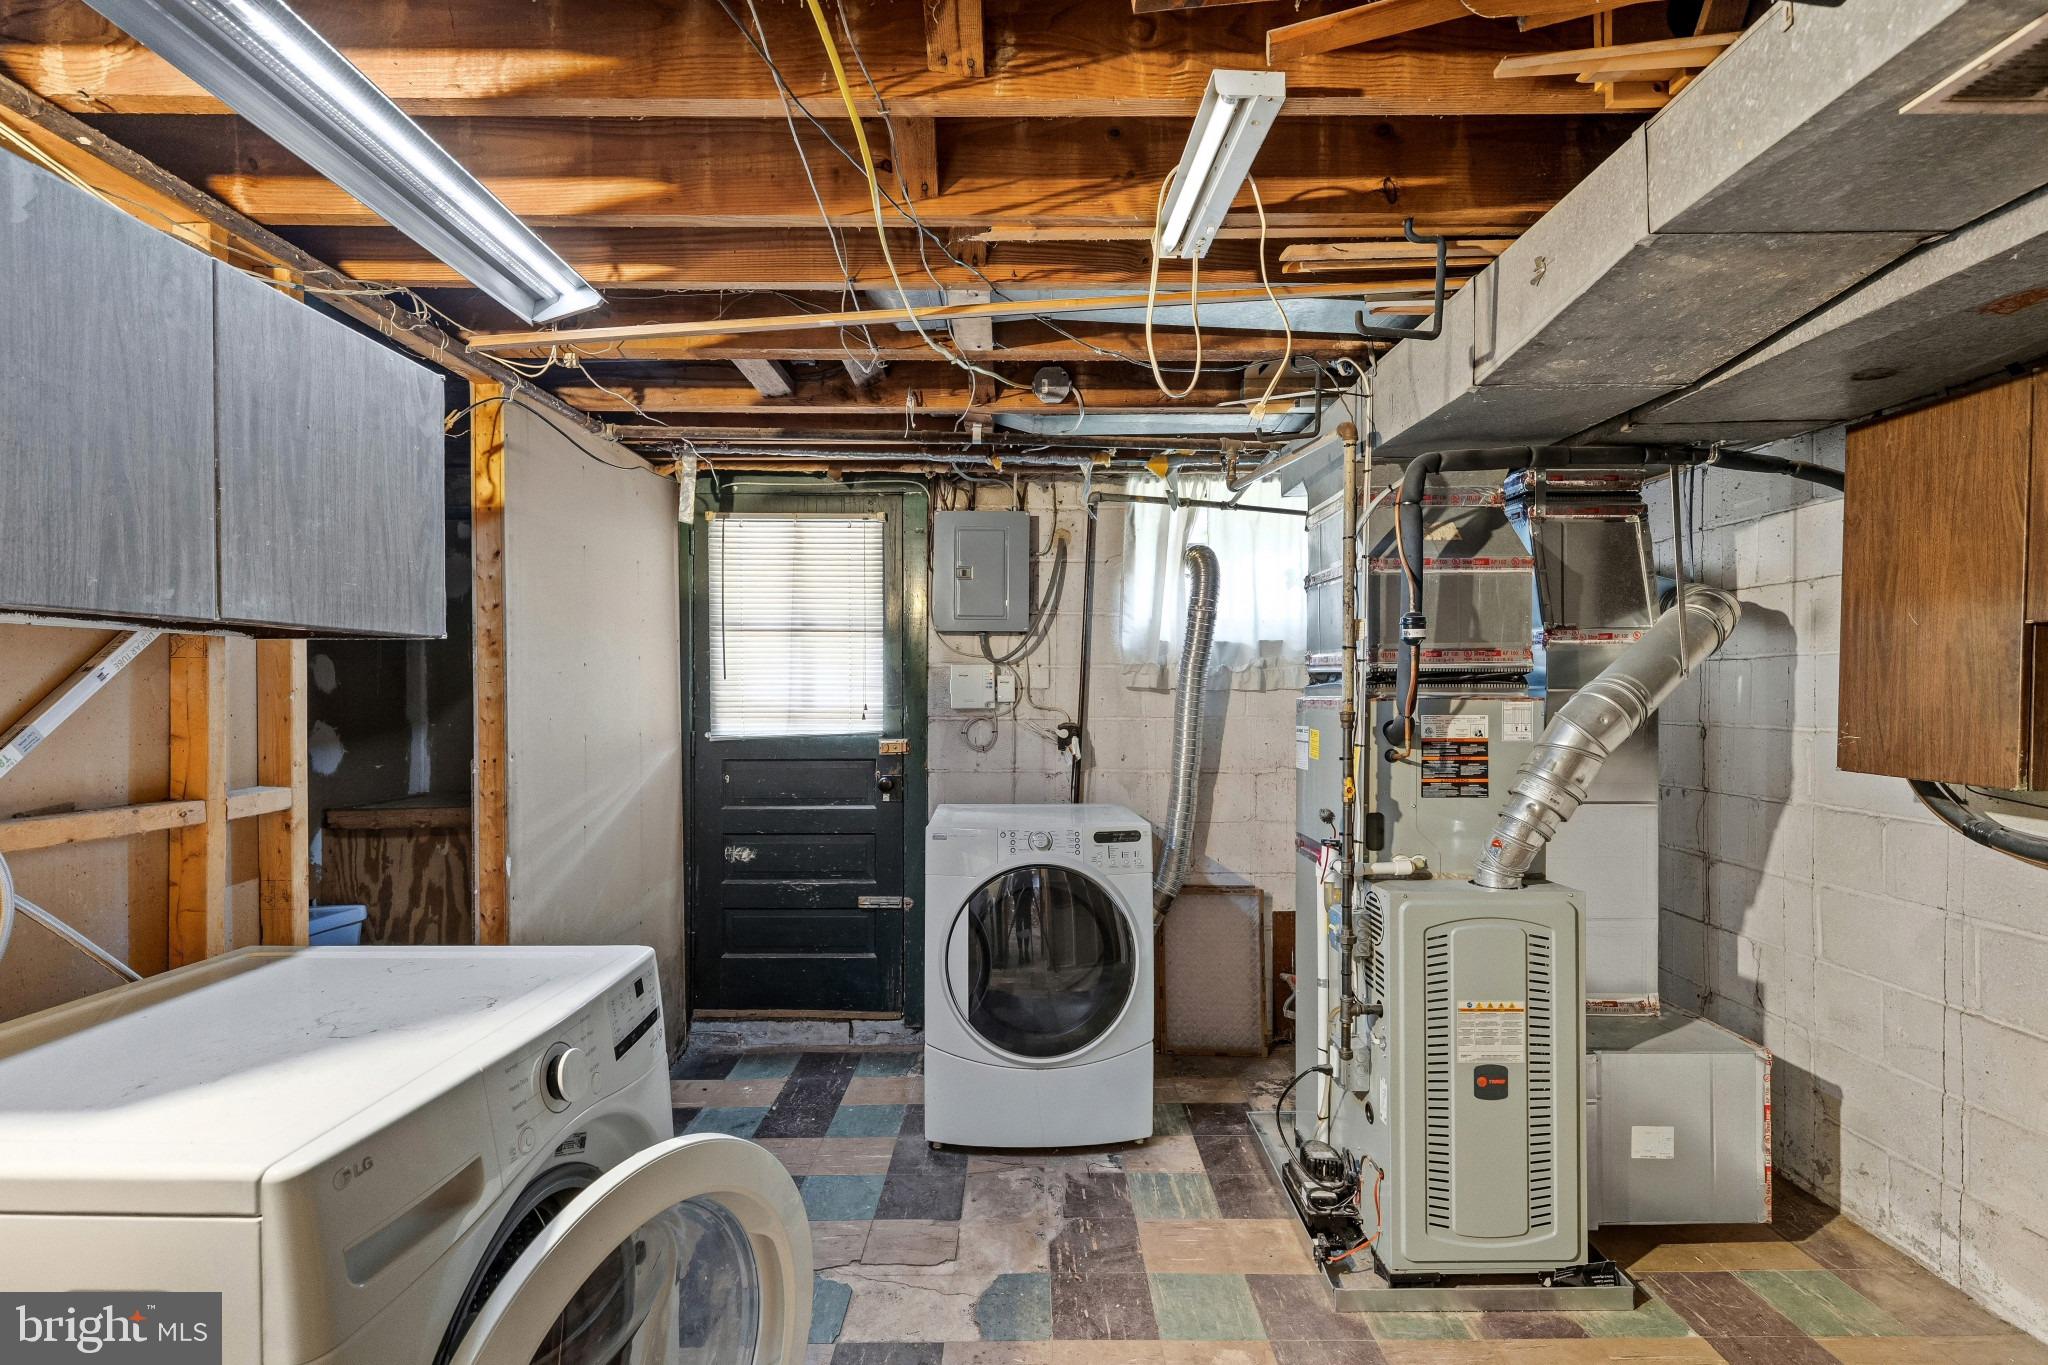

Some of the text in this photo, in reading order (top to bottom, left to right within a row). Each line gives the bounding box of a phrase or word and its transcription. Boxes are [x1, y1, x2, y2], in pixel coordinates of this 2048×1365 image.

[130, 631, 156, 656] LINEAR
[113, 651, 132, 670] TUBE
[354, 1156, 374, 1178] LG
